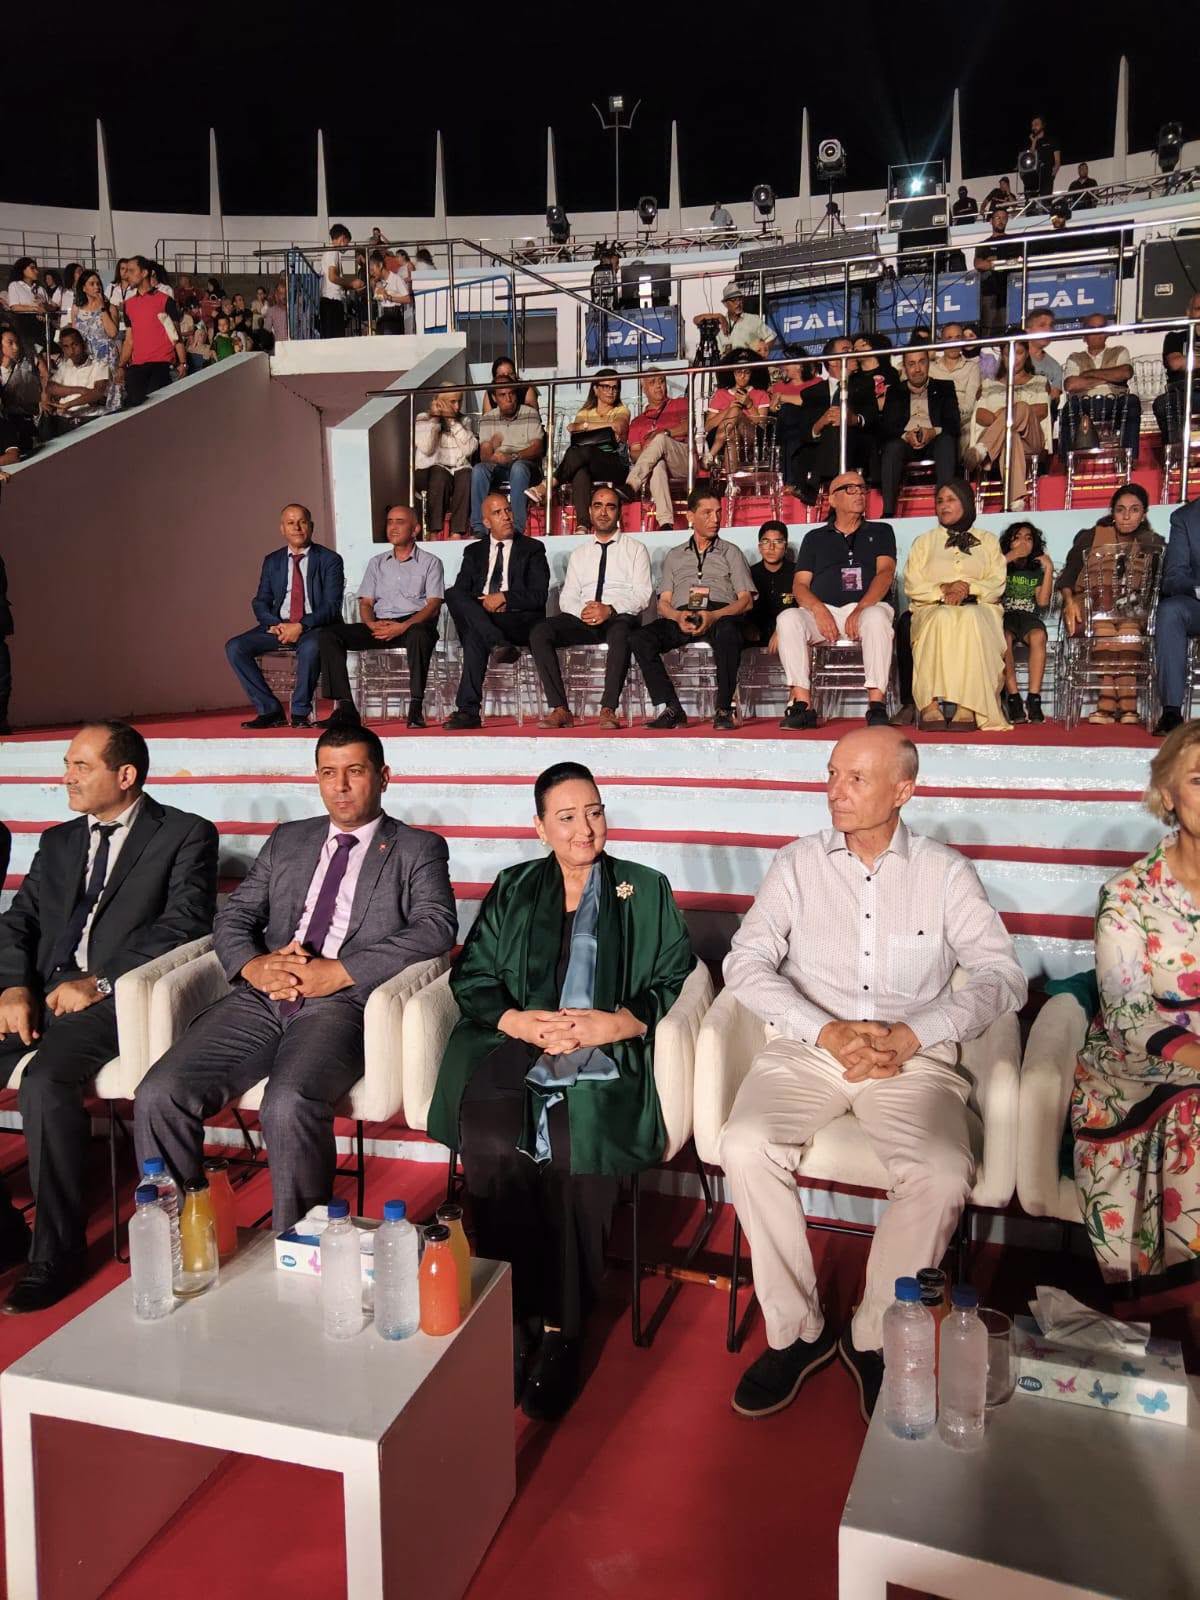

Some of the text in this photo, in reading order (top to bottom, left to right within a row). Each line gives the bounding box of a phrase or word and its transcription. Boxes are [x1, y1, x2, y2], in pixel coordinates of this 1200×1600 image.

[896, 295, 960, 317] PAL
[1028, 288, 1094, 310] PAL
[783, 310, 843, 333] PAL
